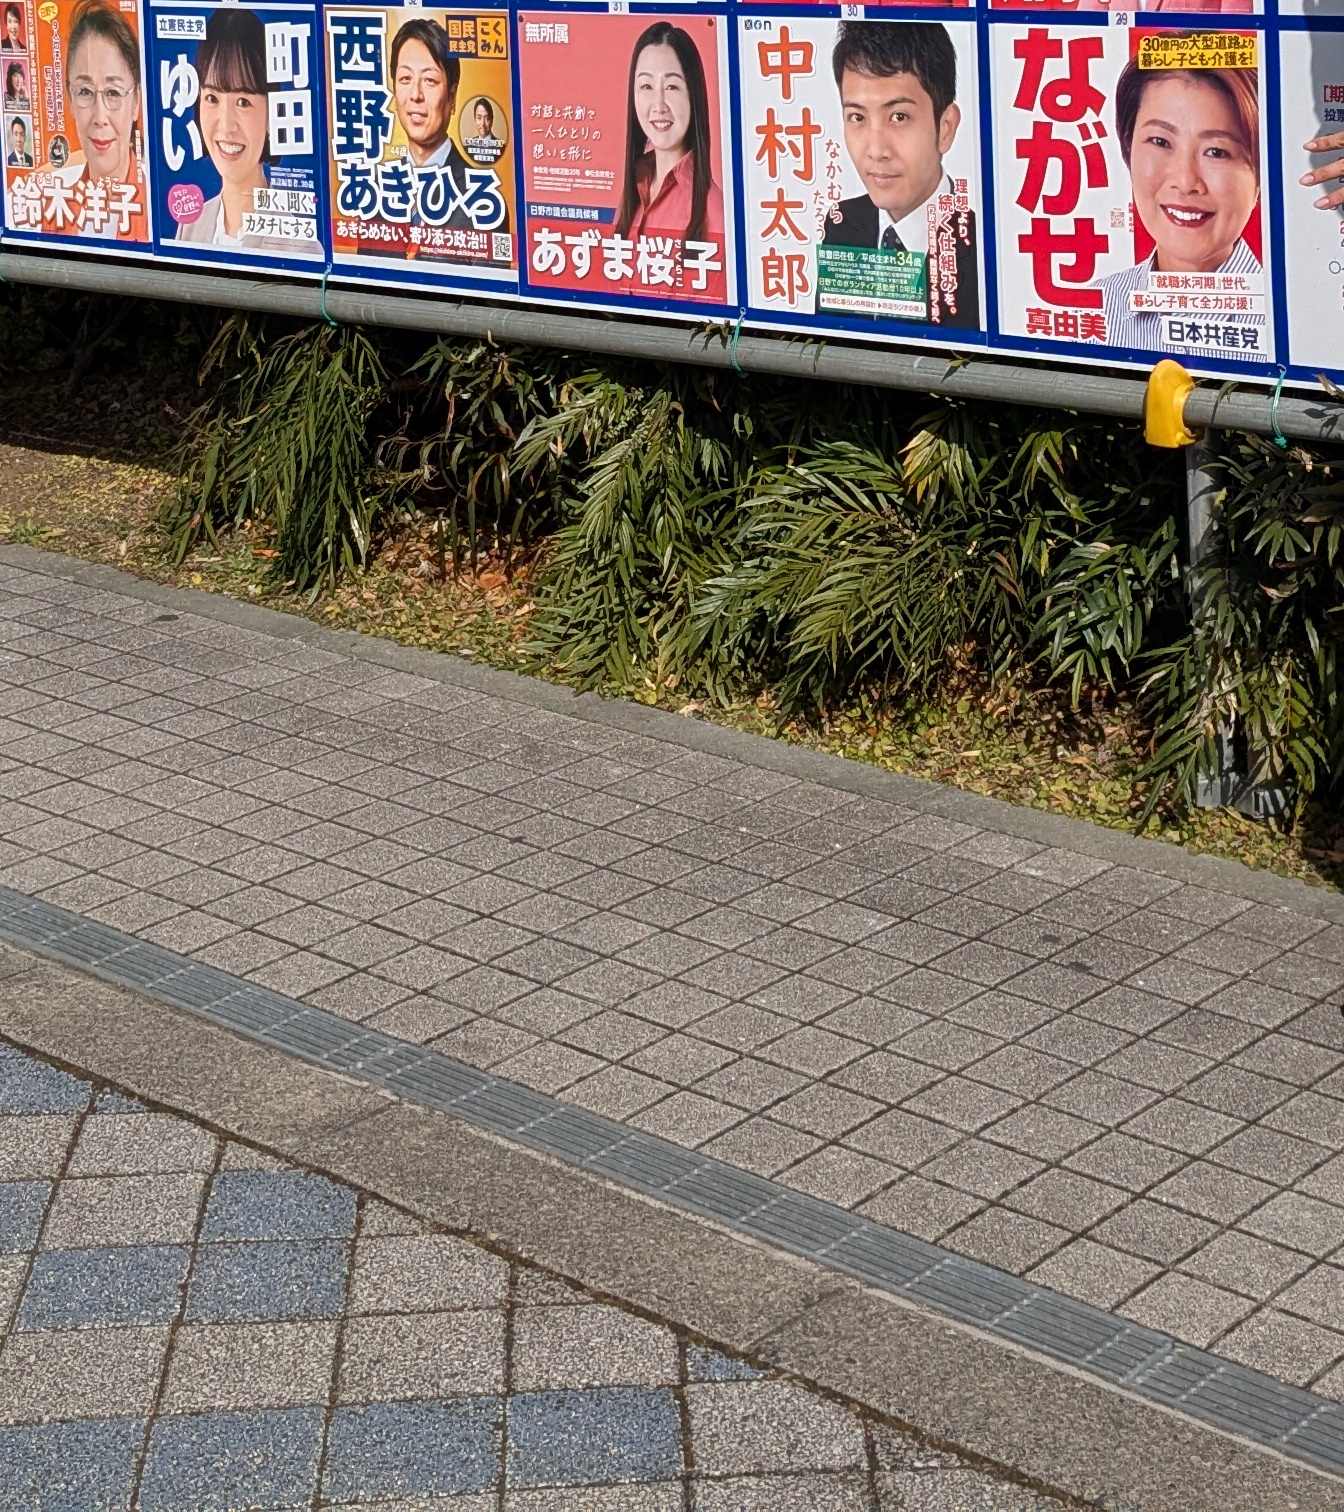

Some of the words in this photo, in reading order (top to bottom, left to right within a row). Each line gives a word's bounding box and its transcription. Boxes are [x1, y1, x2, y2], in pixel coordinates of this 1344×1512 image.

[158, 17, 205, 34] 立憲民主党
[846, 4, 859, 17] 30
[448, 19, 475, 38] 国民
[480, 19, 502, 37] こく
[525, 22, 570, 44] 無所属
[480, 38, 504, 55] みん
[1142, 37, 1256, 53] 30億円の大型道路より
[264, 21, 314, 157] 町田
[329, 14, 394, 160] 西野
[160, 53, 204, 172] ゆい
[530, 104, 597, 121] 対話と共創で
[531, 123, 602, 141] 一人ひとりの
[532, 143, 593, 161] 想いを形に
[755, 24, 822, 307] 中村太郎
[28, 170, 53, 185] すずき
[96, 176, 121, 189] ようこ
[824, 138, 844, 225] なかむら
[1013, 27, 1109, 310] ながせ
[10, 174, 142, 234] 鈴木洋子
[257, 190, 315, 213] 動く、聞く、
[339, 164, 503, 227] あきひろ
[245, 215, 315, 238] カタチにする
[529, 204, 600, 221] 日野市議会議員候補
[812, 188, 827, 242] たろう
[336, 220, 488, 250] あきらめない、寄り添う政治!!
[531, 228, 723, 291] あずま桜子
[674, 237, 684, 288] さくらこ
[937, 193, 958, 315] 続く仕組みを。
[1024, 307, 1108, 343] 真由美
[1168, 320, 1260, 350] 日本共産党
